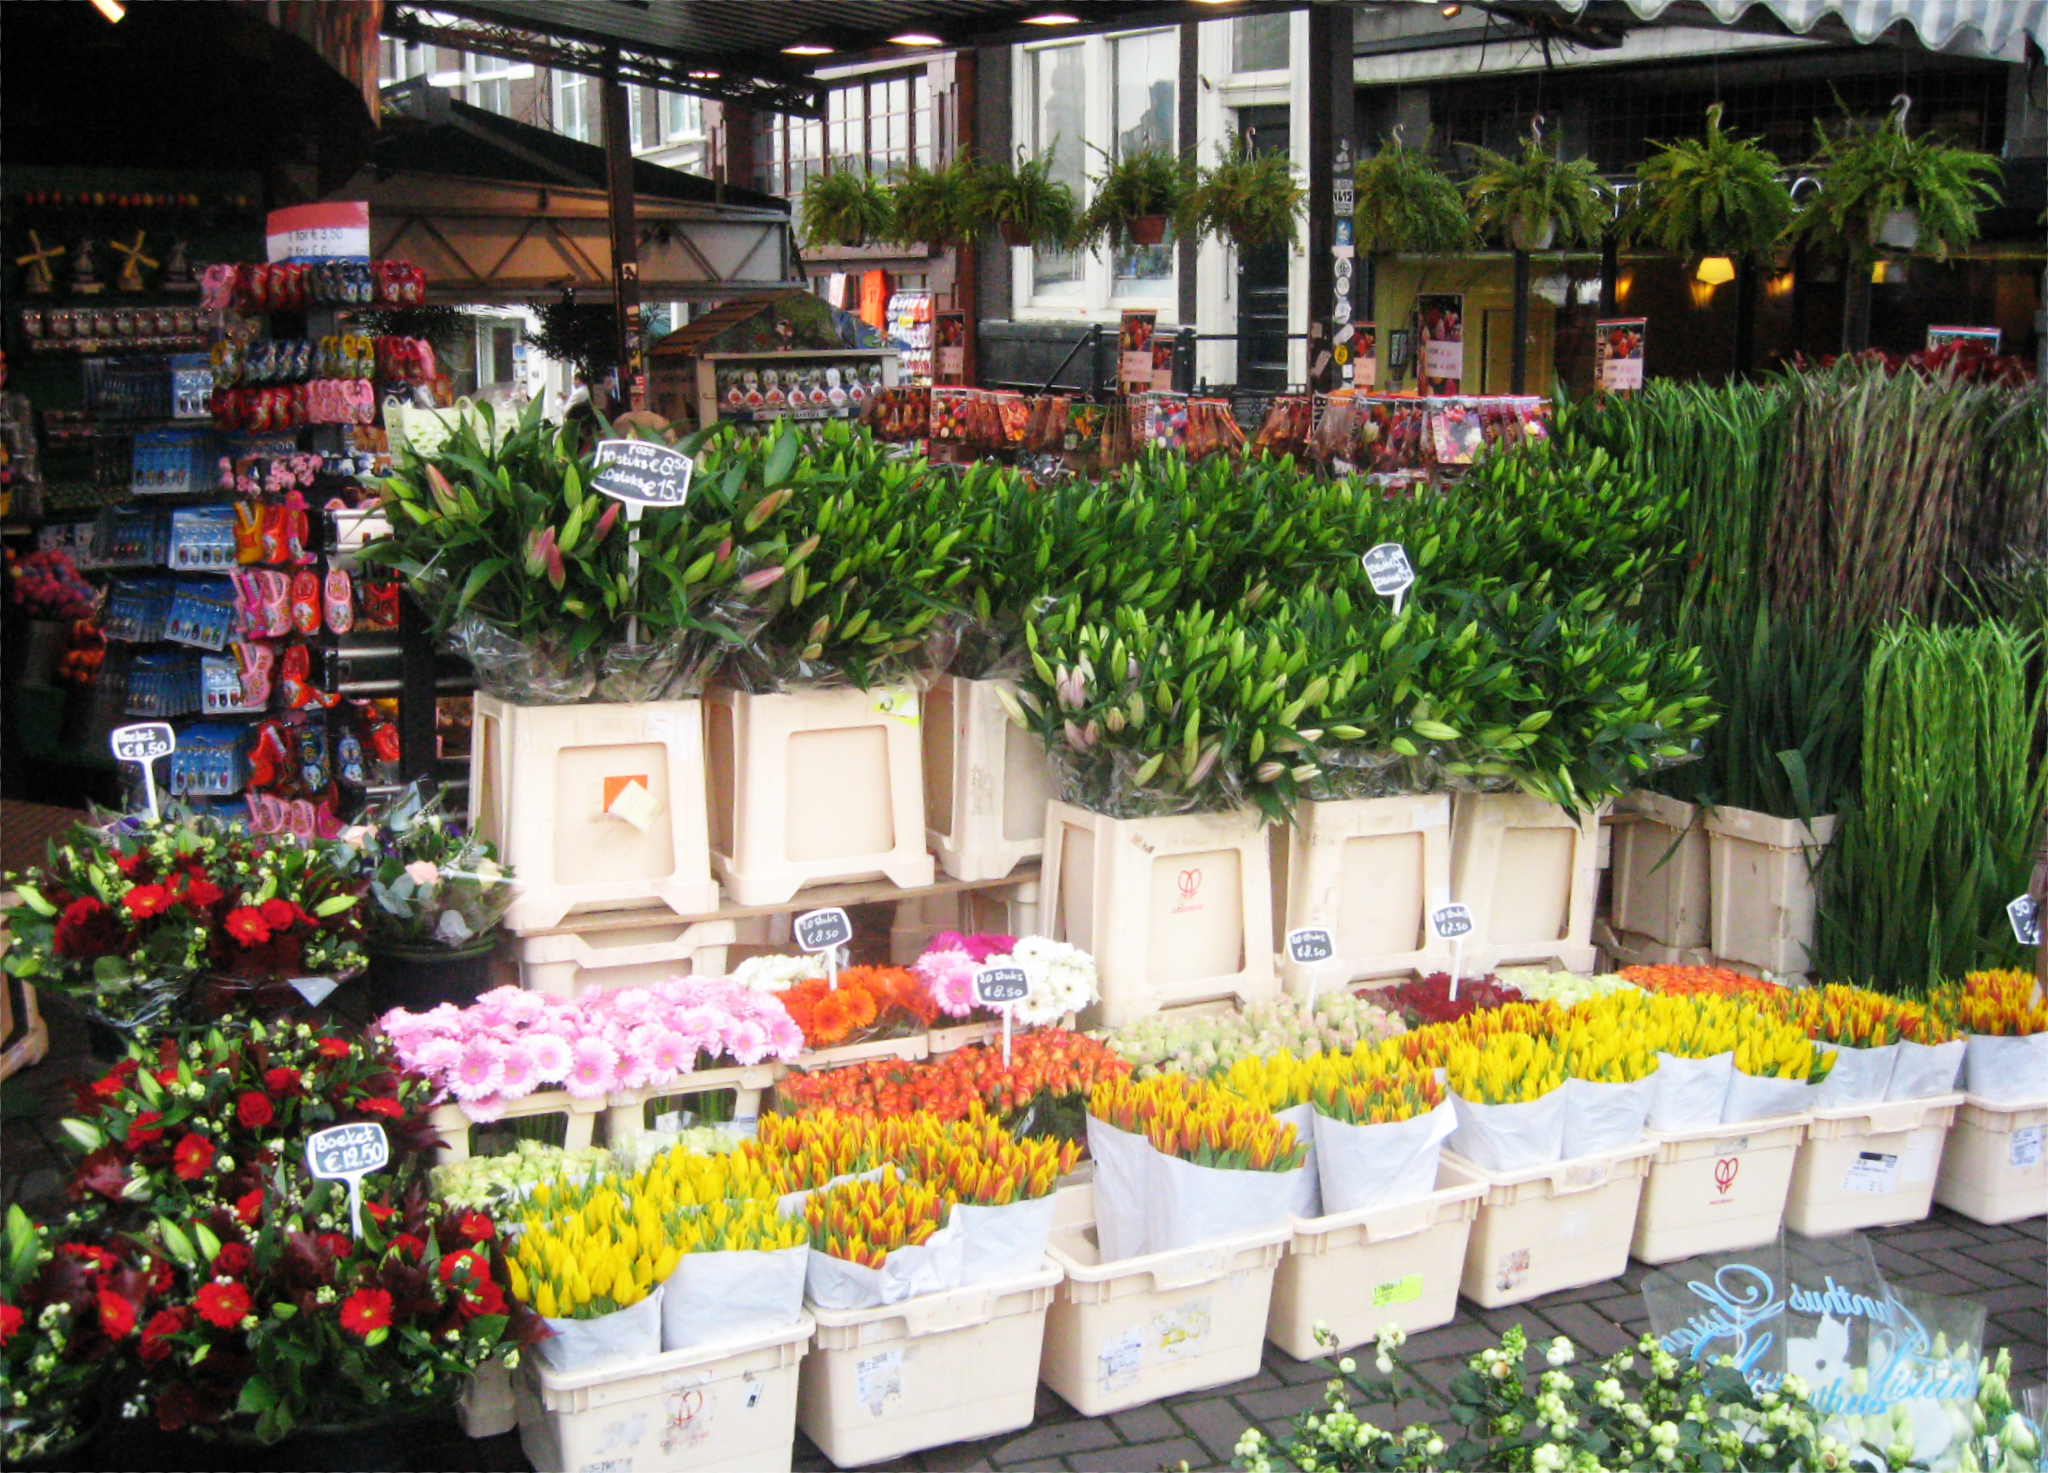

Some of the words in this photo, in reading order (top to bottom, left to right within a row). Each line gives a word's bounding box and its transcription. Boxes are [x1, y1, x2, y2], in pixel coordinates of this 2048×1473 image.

[296, 229, 308, 241] for
[629, 445, 656, 457] roze
[616, 454, 648, 469] stuks
[979, 973, 993, 984] 20
[315, 1126, 375, 1152] Boeket
